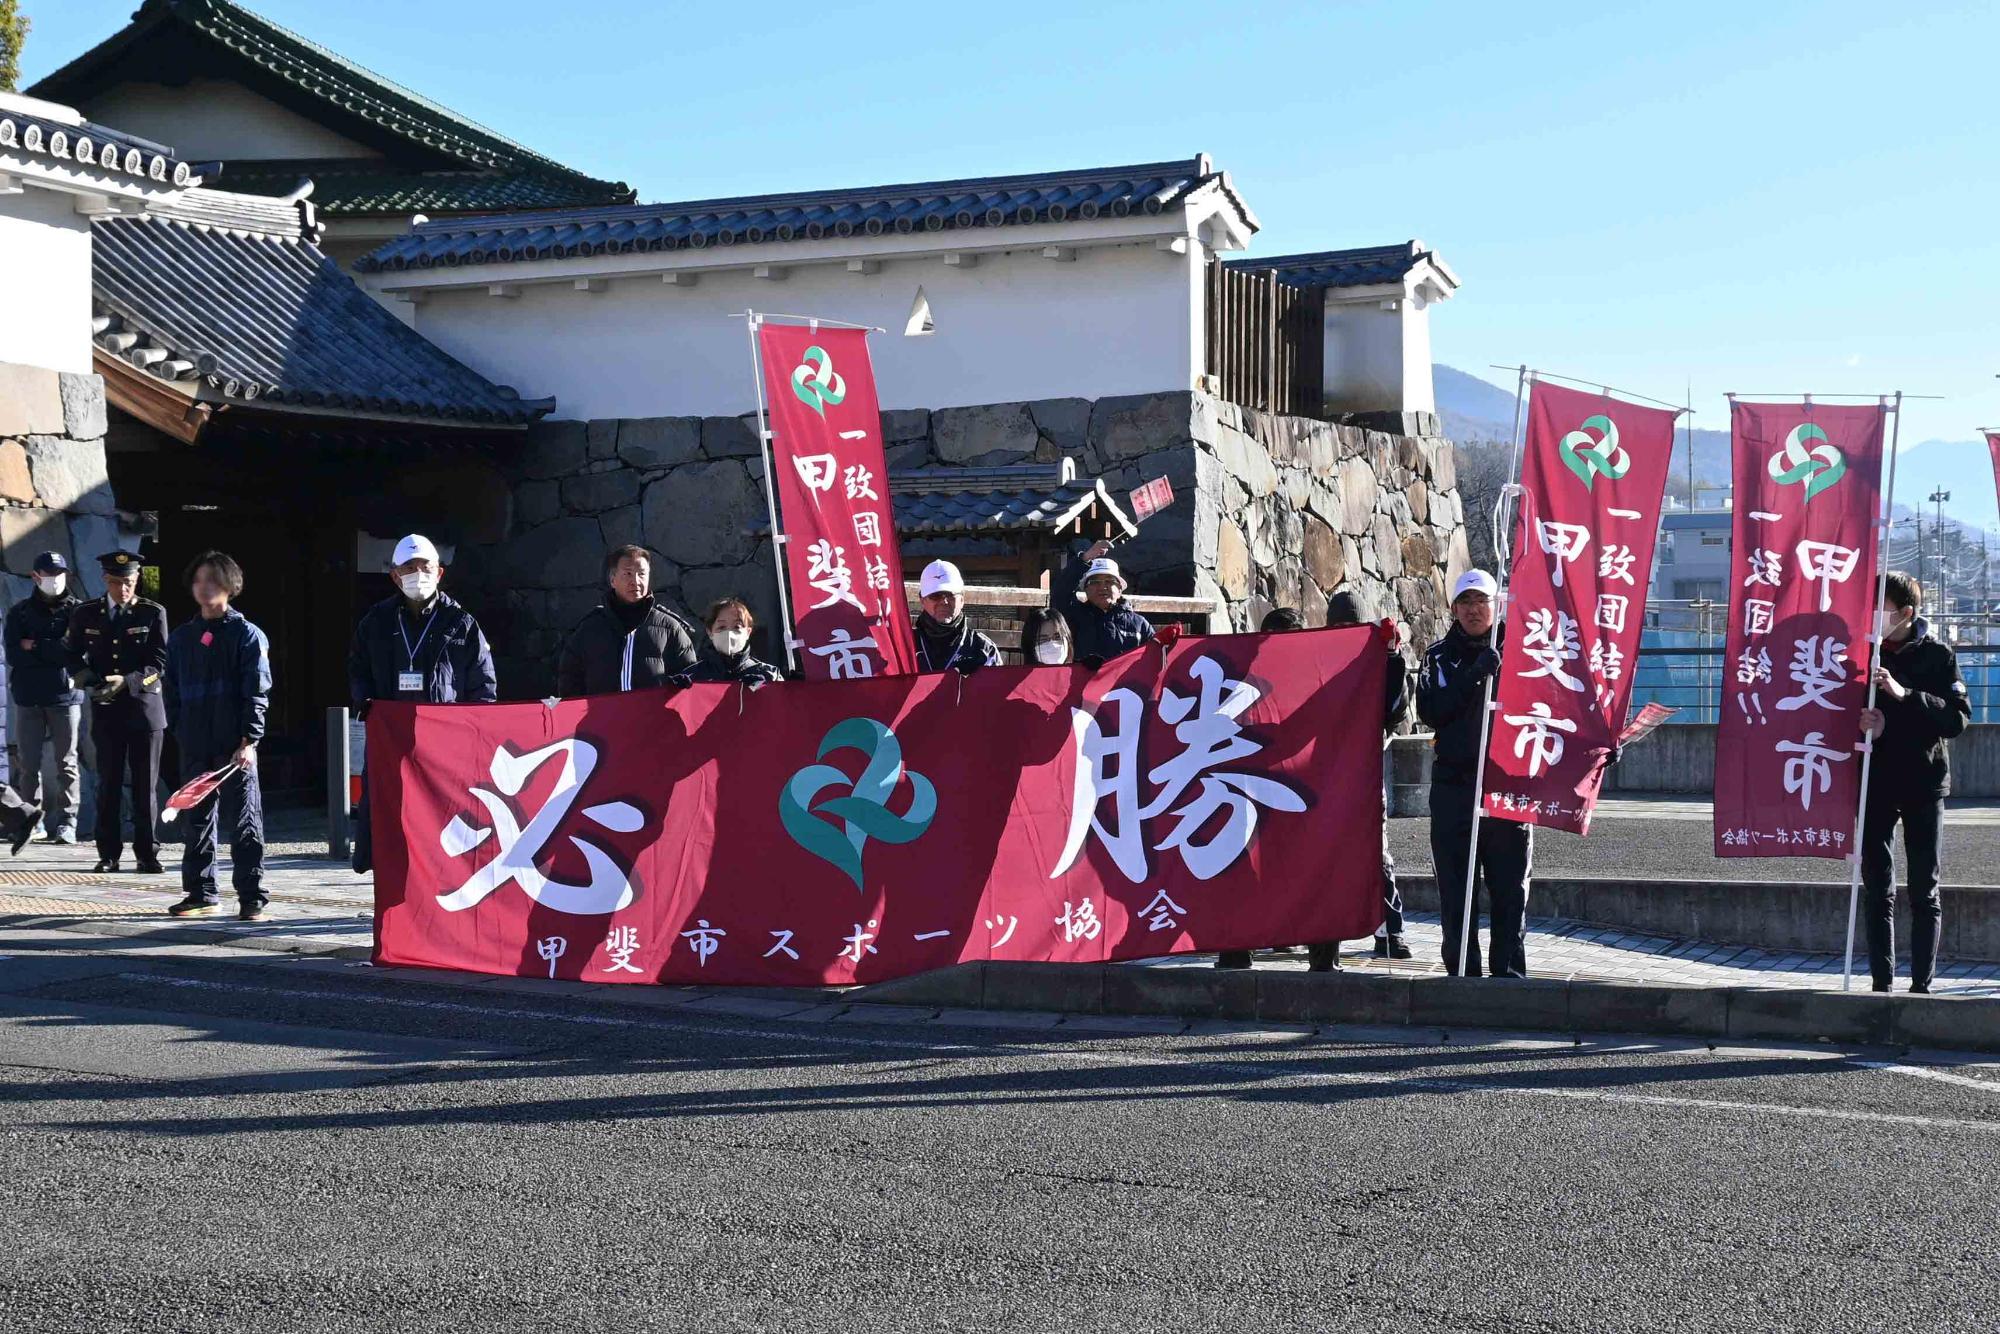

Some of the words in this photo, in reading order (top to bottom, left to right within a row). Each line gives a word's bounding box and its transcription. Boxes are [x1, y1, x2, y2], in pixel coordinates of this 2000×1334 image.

[791, 452, 879, 679] 甲斐市
[1502, 515, 1591, 779] 甲斐市
[536, 889, 1187, 979] 甲斐市スポーツ協会
